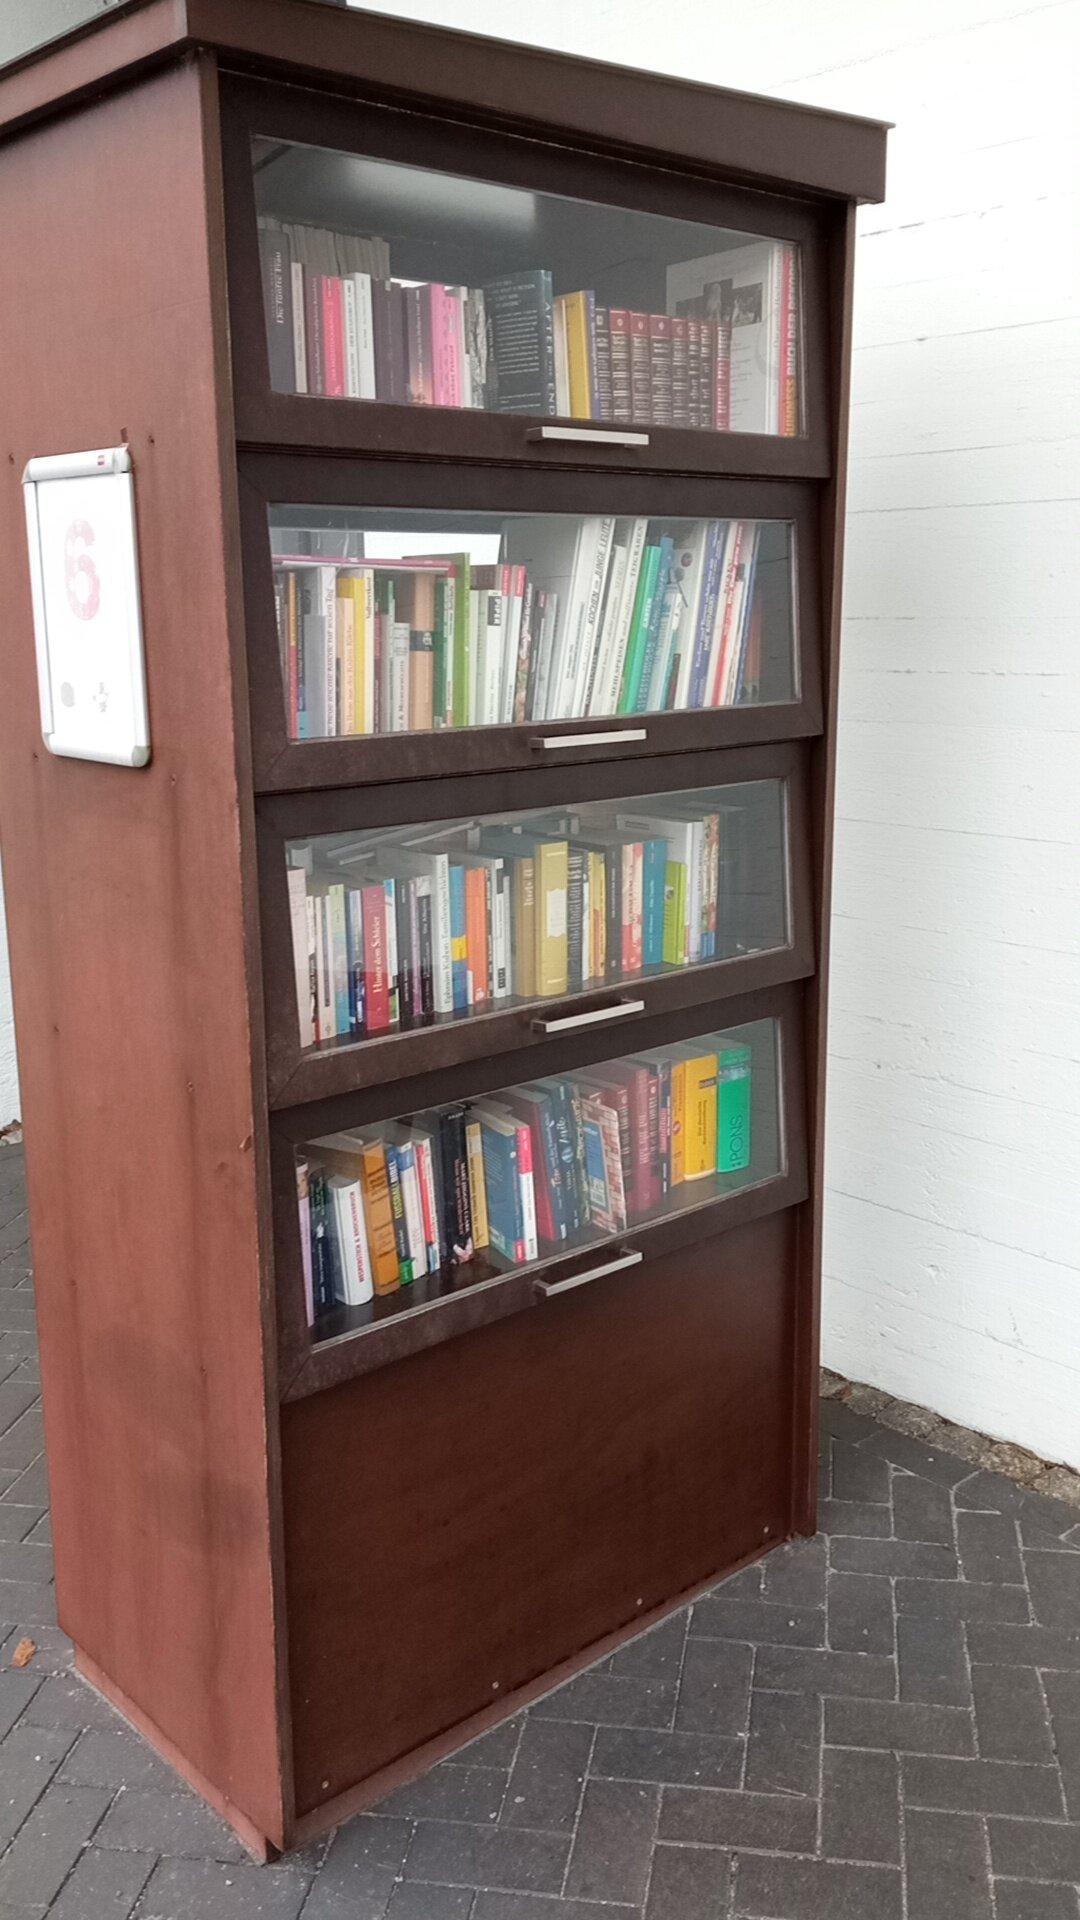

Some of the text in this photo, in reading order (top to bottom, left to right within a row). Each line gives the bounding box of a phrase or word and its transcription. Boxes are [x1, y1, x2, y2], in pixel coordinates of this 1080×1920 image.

[544, 302, 554, 354] AFTER
[786, 312, 796, 339] DER
[786, 342, 797, 376] BUCH
[547, 382, 557, 416] END
[598, 520, 612, 547] LEUTE
[64, 518, 101, 621] 6
[591, 550, 606, 577] JUNGE
[586, 592, 600, 625] KOCHEN
[610, 638, 626, 698] MEHLSPEISEN
[629, 526, 644, 577] TEIGWAREN
[440, 859, 452, 1005] Ephraim Kishon Familiengeschichten
[370, 915, 384, 993] Hinter dem Schleier
[728, 1113, 745, 1162] PONS
[388, 1160, 402, 1220] FUSSBALL BIBEL
[550, 1167, 562, 1187] Tom
[355, 1244, 365, 1283] WESPENSTICH
